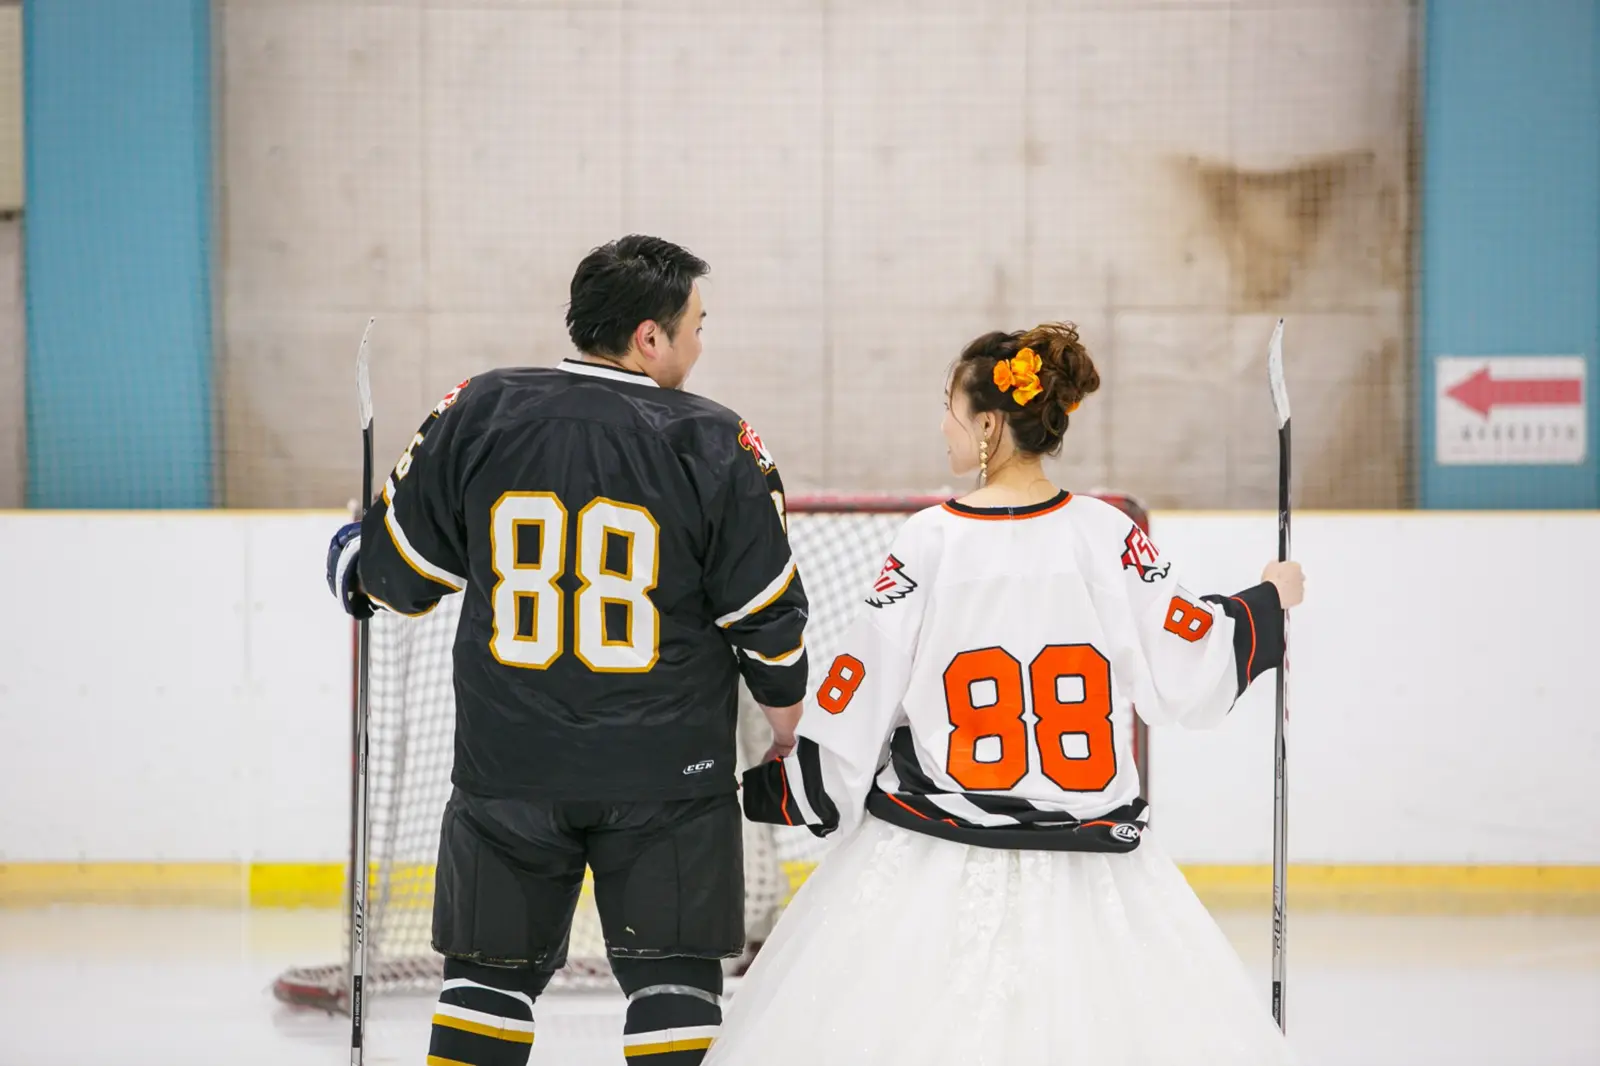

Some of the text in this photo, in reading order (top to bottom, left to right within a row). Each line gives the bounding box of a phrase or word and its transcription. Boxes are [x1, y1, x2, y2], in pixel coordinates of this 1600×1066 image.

[490, 491, 661, 672] 88
[1163, 595, 1213, 643] 8
[816, 653, 866, 715] 8
[943, 643, 1117, 792] 88
